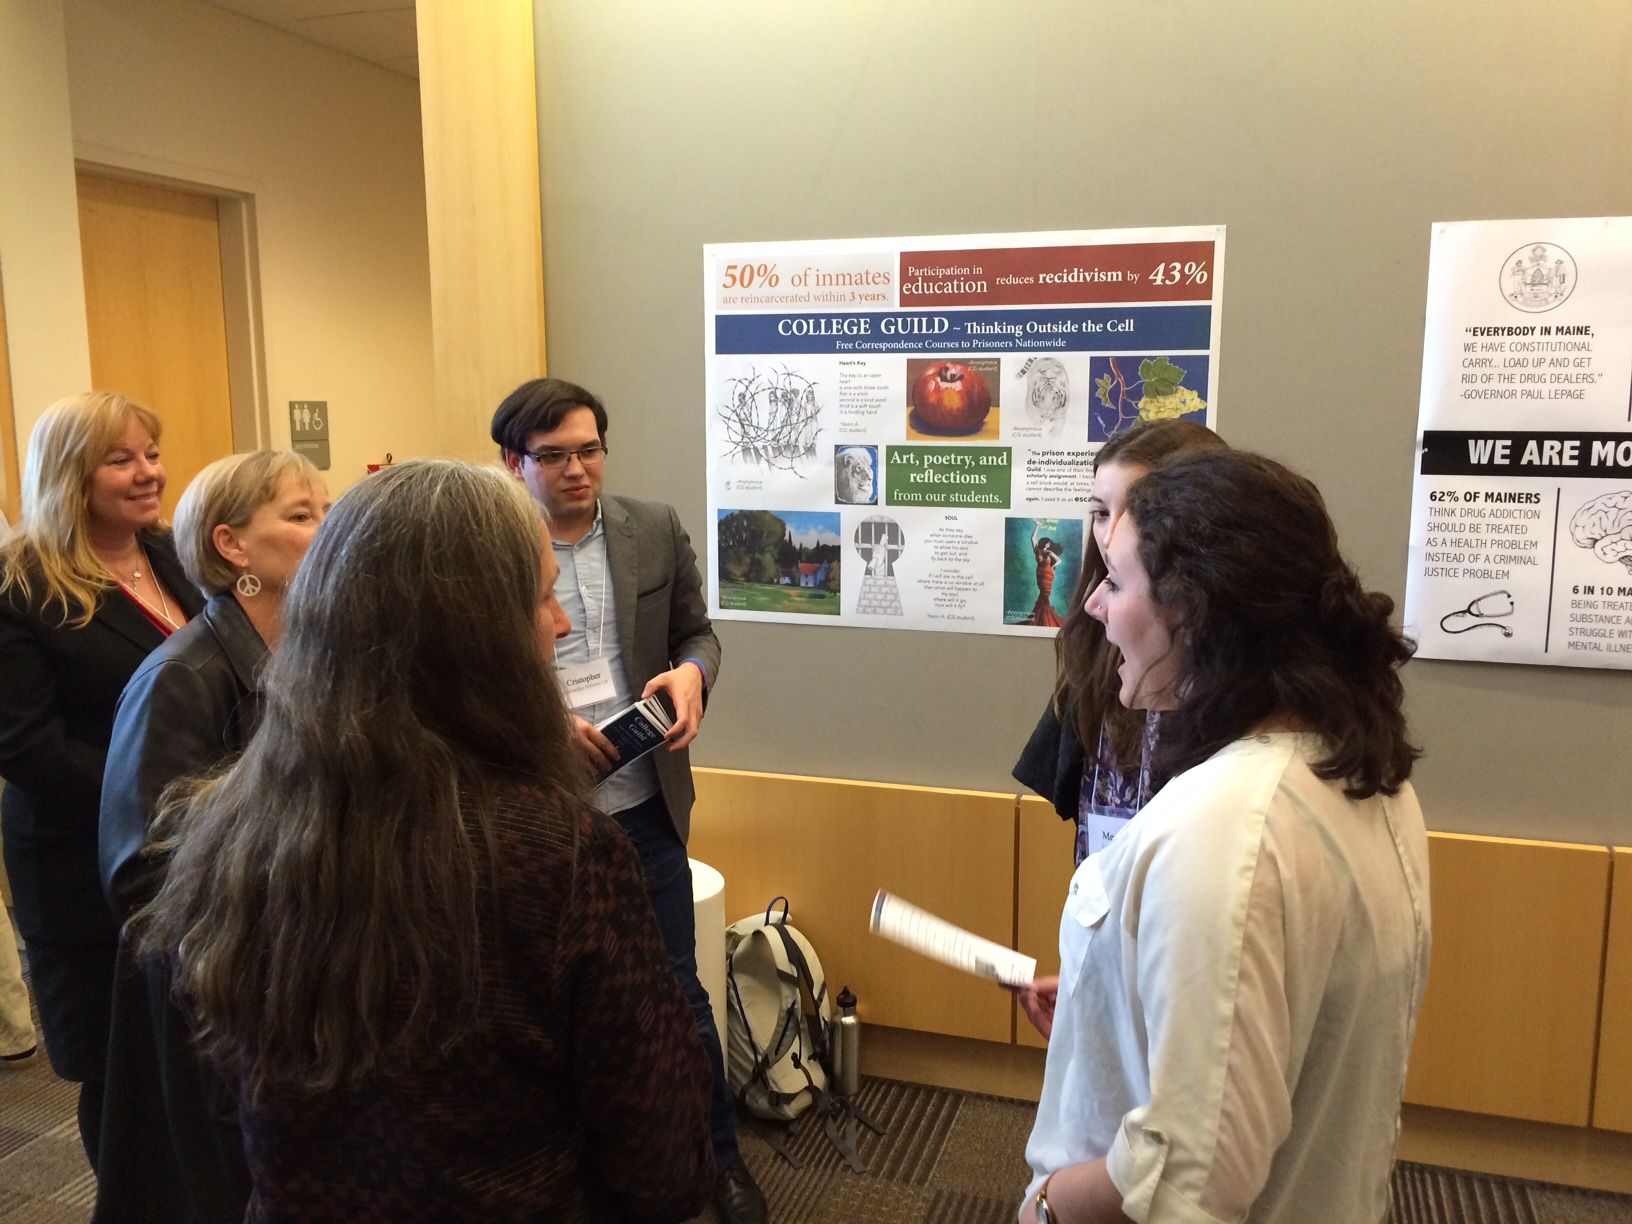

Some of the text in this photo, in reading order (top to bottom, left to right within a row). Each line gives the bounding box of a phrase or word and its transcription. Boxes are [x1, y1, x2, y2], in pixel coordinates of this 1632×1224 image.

[722, 263, 891, 288] 50% of inmates
[908, 265, 983, 278] Participation in
[996, 261, 1208, 286] reduces recidivism by 43%
[902, 277, 988, 294] education
[740, 292, 810, 304] reincarcerated
[814, 291, 846, 302] within
[849, 292, 856, 301] 3
[858, 293, 889, 304] years.
[778, 318, 871, 336] COLLEGE
[880, 316, 949, 335] GUILD
[964, 322, 1023, 336] Thinking
[1026, 321, 1078, 334] Outside
[1082, 320, 1103, 333] the
[1106, 319, 1134, 332] Cell
[1540, 326, 1551, 336] IN
[1556, 326, 1594, 338] MAINE,
[836, 338, 1066, 350] Free Correspondence Courses to Prisoners Nationwide
[1464, 342, 1592, 352] WE HAVE CONSTITUTIONAL
[1504, 358, 1528, 368] LOAD
[1532, 358, 1546, 368] UP
[1548, 358, 1570, 368] AND
[1573, 358, 1592, 368] GET
[1462, 374, 1477, 384] RID
[1481, 374, 1494, 383] OF
[1498, 374, 1516, 383] THE
[1520, 374, 1546, 383] DRUG
[1460, 389, 1585, 400] -GOVERNOR PAUL LEPAGE
[1468, 440, 1632, 467] WE ARE MO
[890, 451, 1008, 469] Art, poetry, and
[910, 469, 987, 484] reflections
[894, 489, 1002, 503] from our students.
[1430, 491, 1541, 504] 62% OF MAINERS
[1429, 507, 1541, 519] THINK DRUG ADDICTION
[1427, 522, 1527, 534] SHOULD BE TREATED
[1426, 538, 1538, 550] AS A HEALTH PROBLEM
[1425, 552, 1538, 565] INSTEAD OF A CRIMINAL
[1424, 567, 1510, 579] JUSTICE PROBLEM
[1572, 585, 1579, 594] 6
[1584, 586, 1594, 595] IN
[1600, 587, 1614, 595] 10
[1571, 600, 1598, 609] BEING
[1570, 613, 1622, 624] SUBSTANCE
[1568, 627, 1614, 638] STRUGGLE
[1568, 641, 1603, 651] MENTAL
[629, 724, 647, 740] Guild
[635, 716, 656, 738] College
